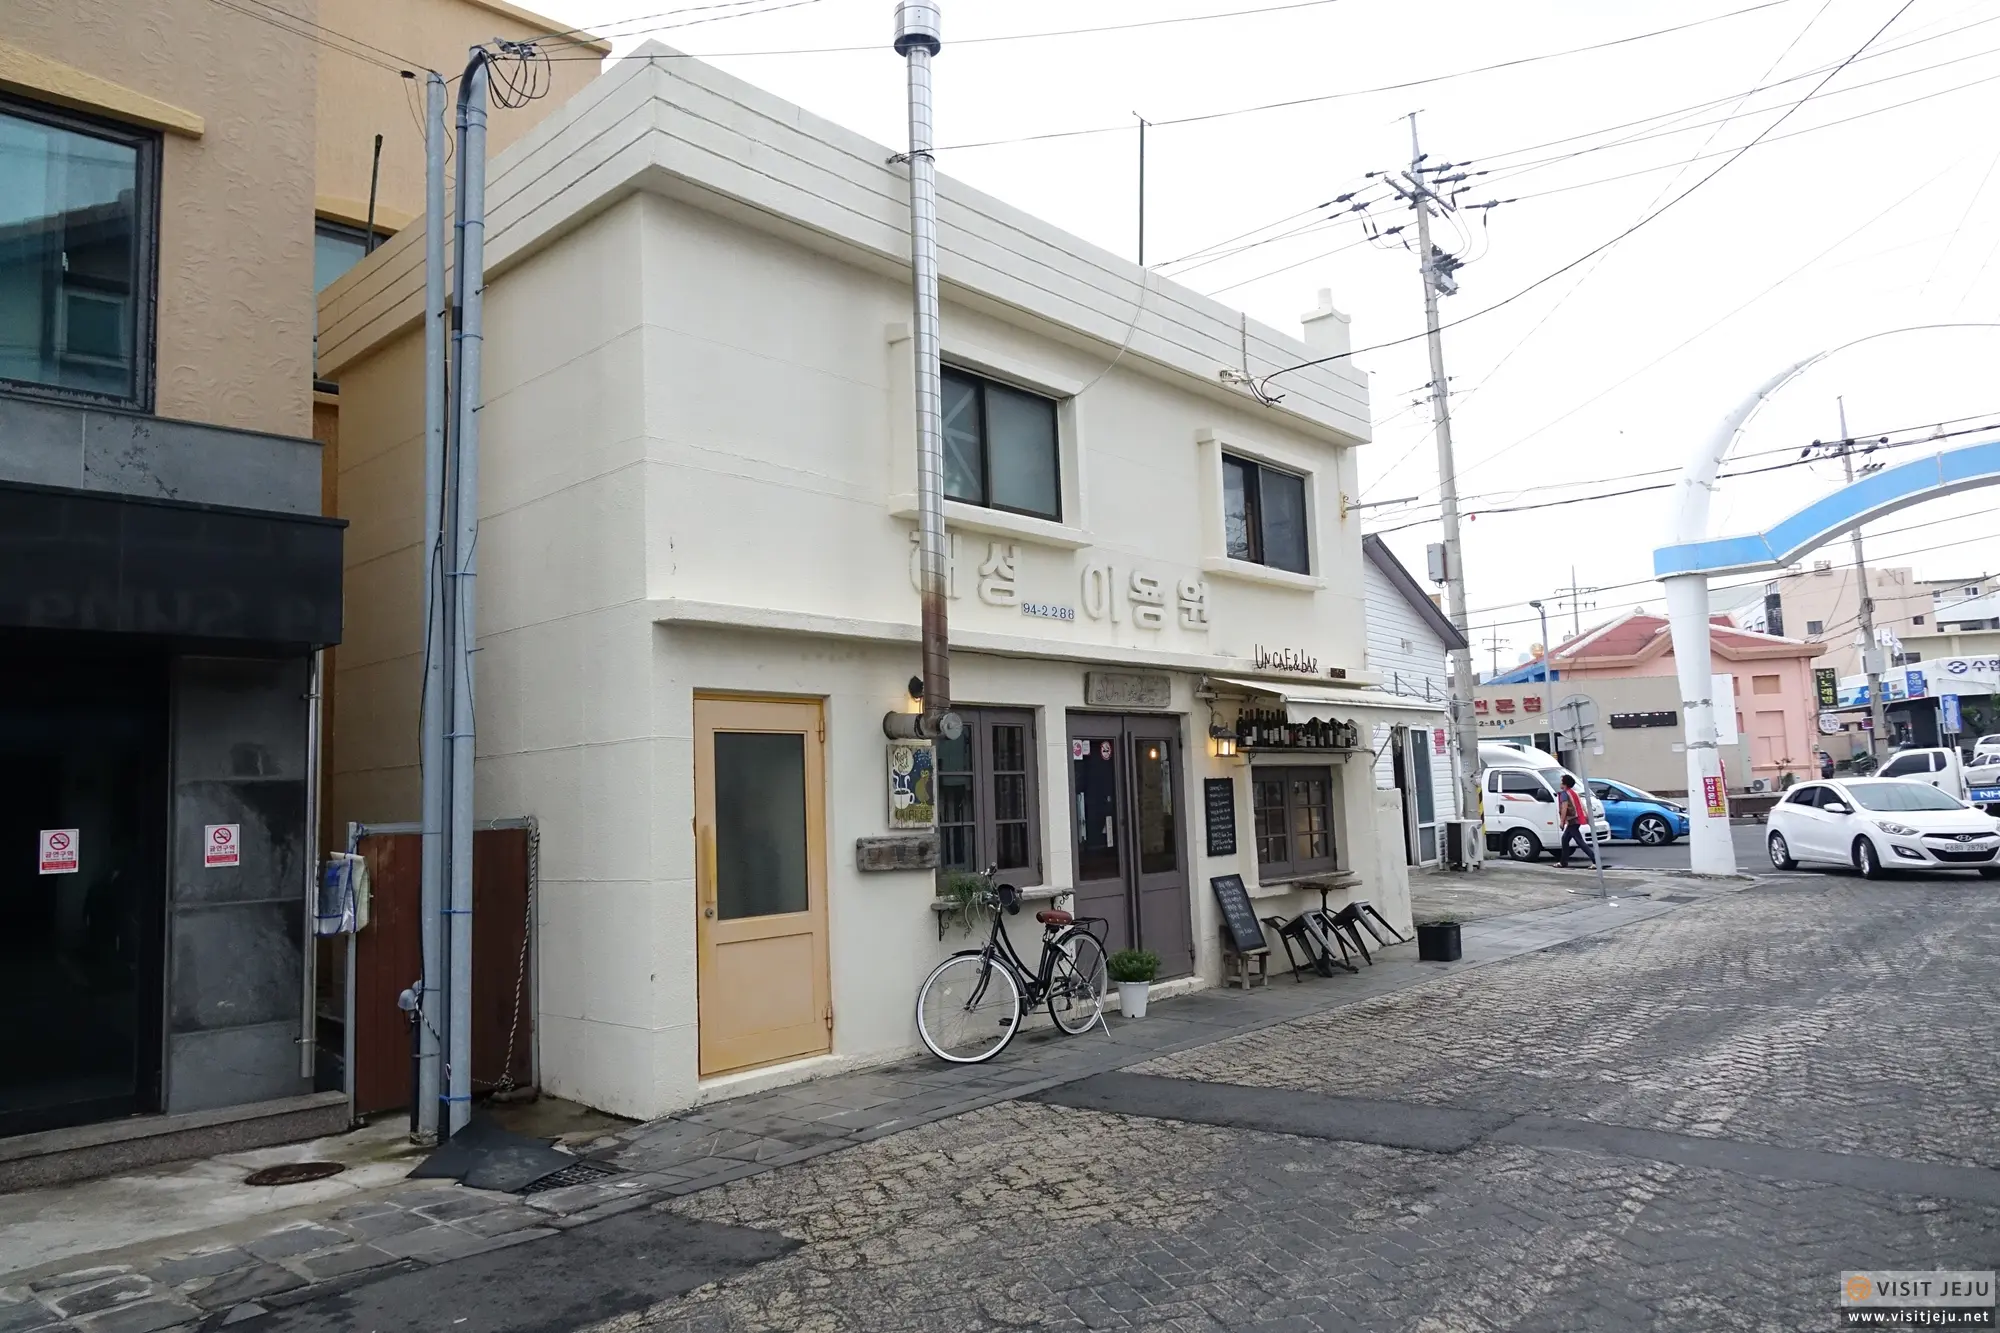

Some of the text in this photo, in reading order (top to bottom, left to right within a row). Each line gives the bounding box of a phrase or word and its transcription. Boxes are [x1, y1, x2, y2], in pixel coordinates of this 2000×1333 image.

[1081, 562, 1210, 632] 이용원
[210, 844, 236, 853] 금연구역
[45, 850, 74, 859] 금연구역
